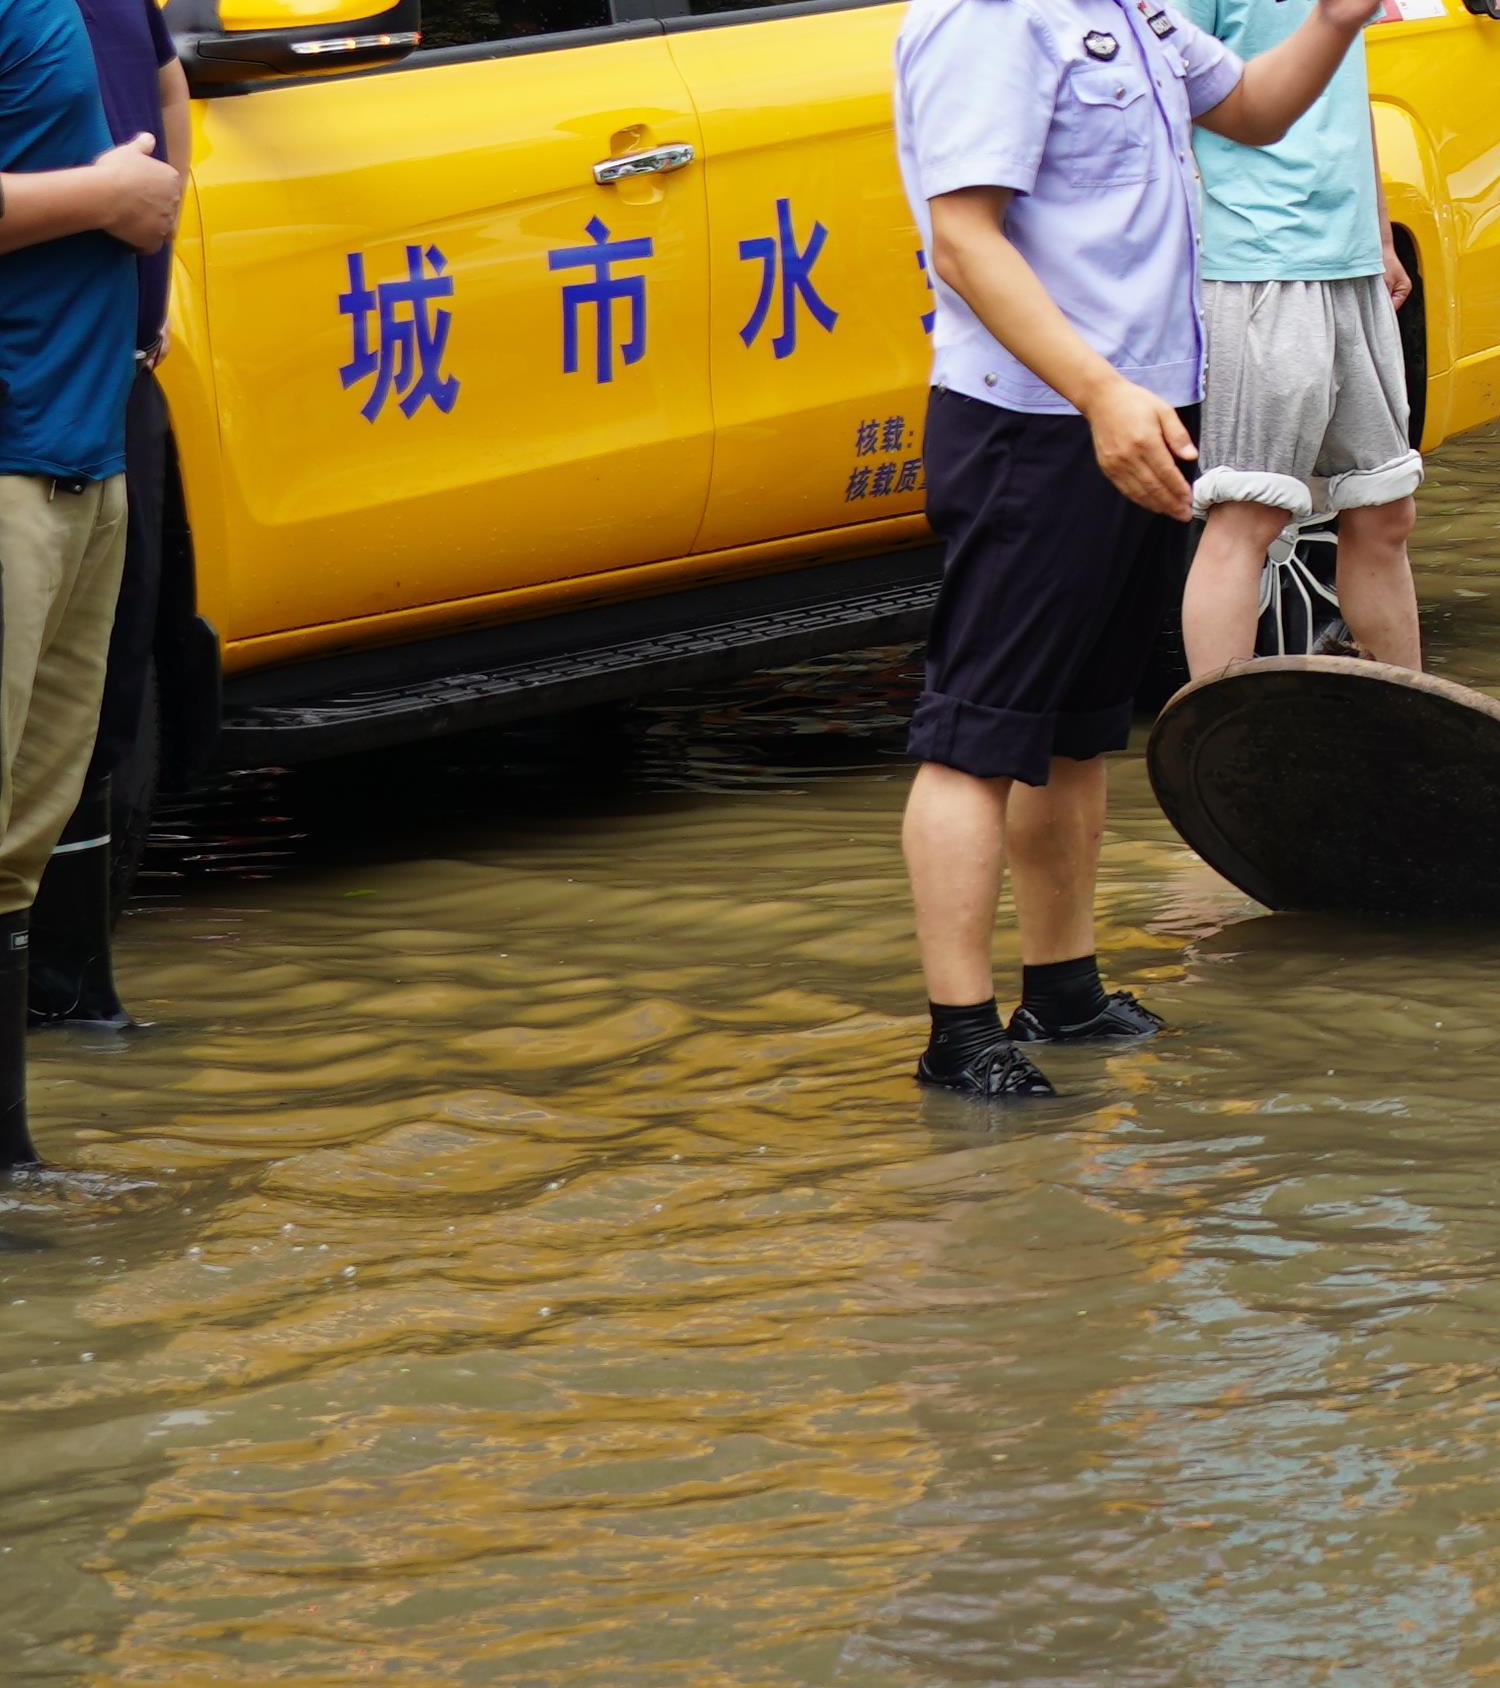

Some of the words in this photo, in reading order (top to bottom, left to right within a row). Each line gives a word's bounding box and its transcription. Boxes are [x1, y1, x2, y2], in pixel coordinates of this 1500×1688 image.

[337, 197, 934, 422] 城市水
[844, 457, 927, 504] 核载质
